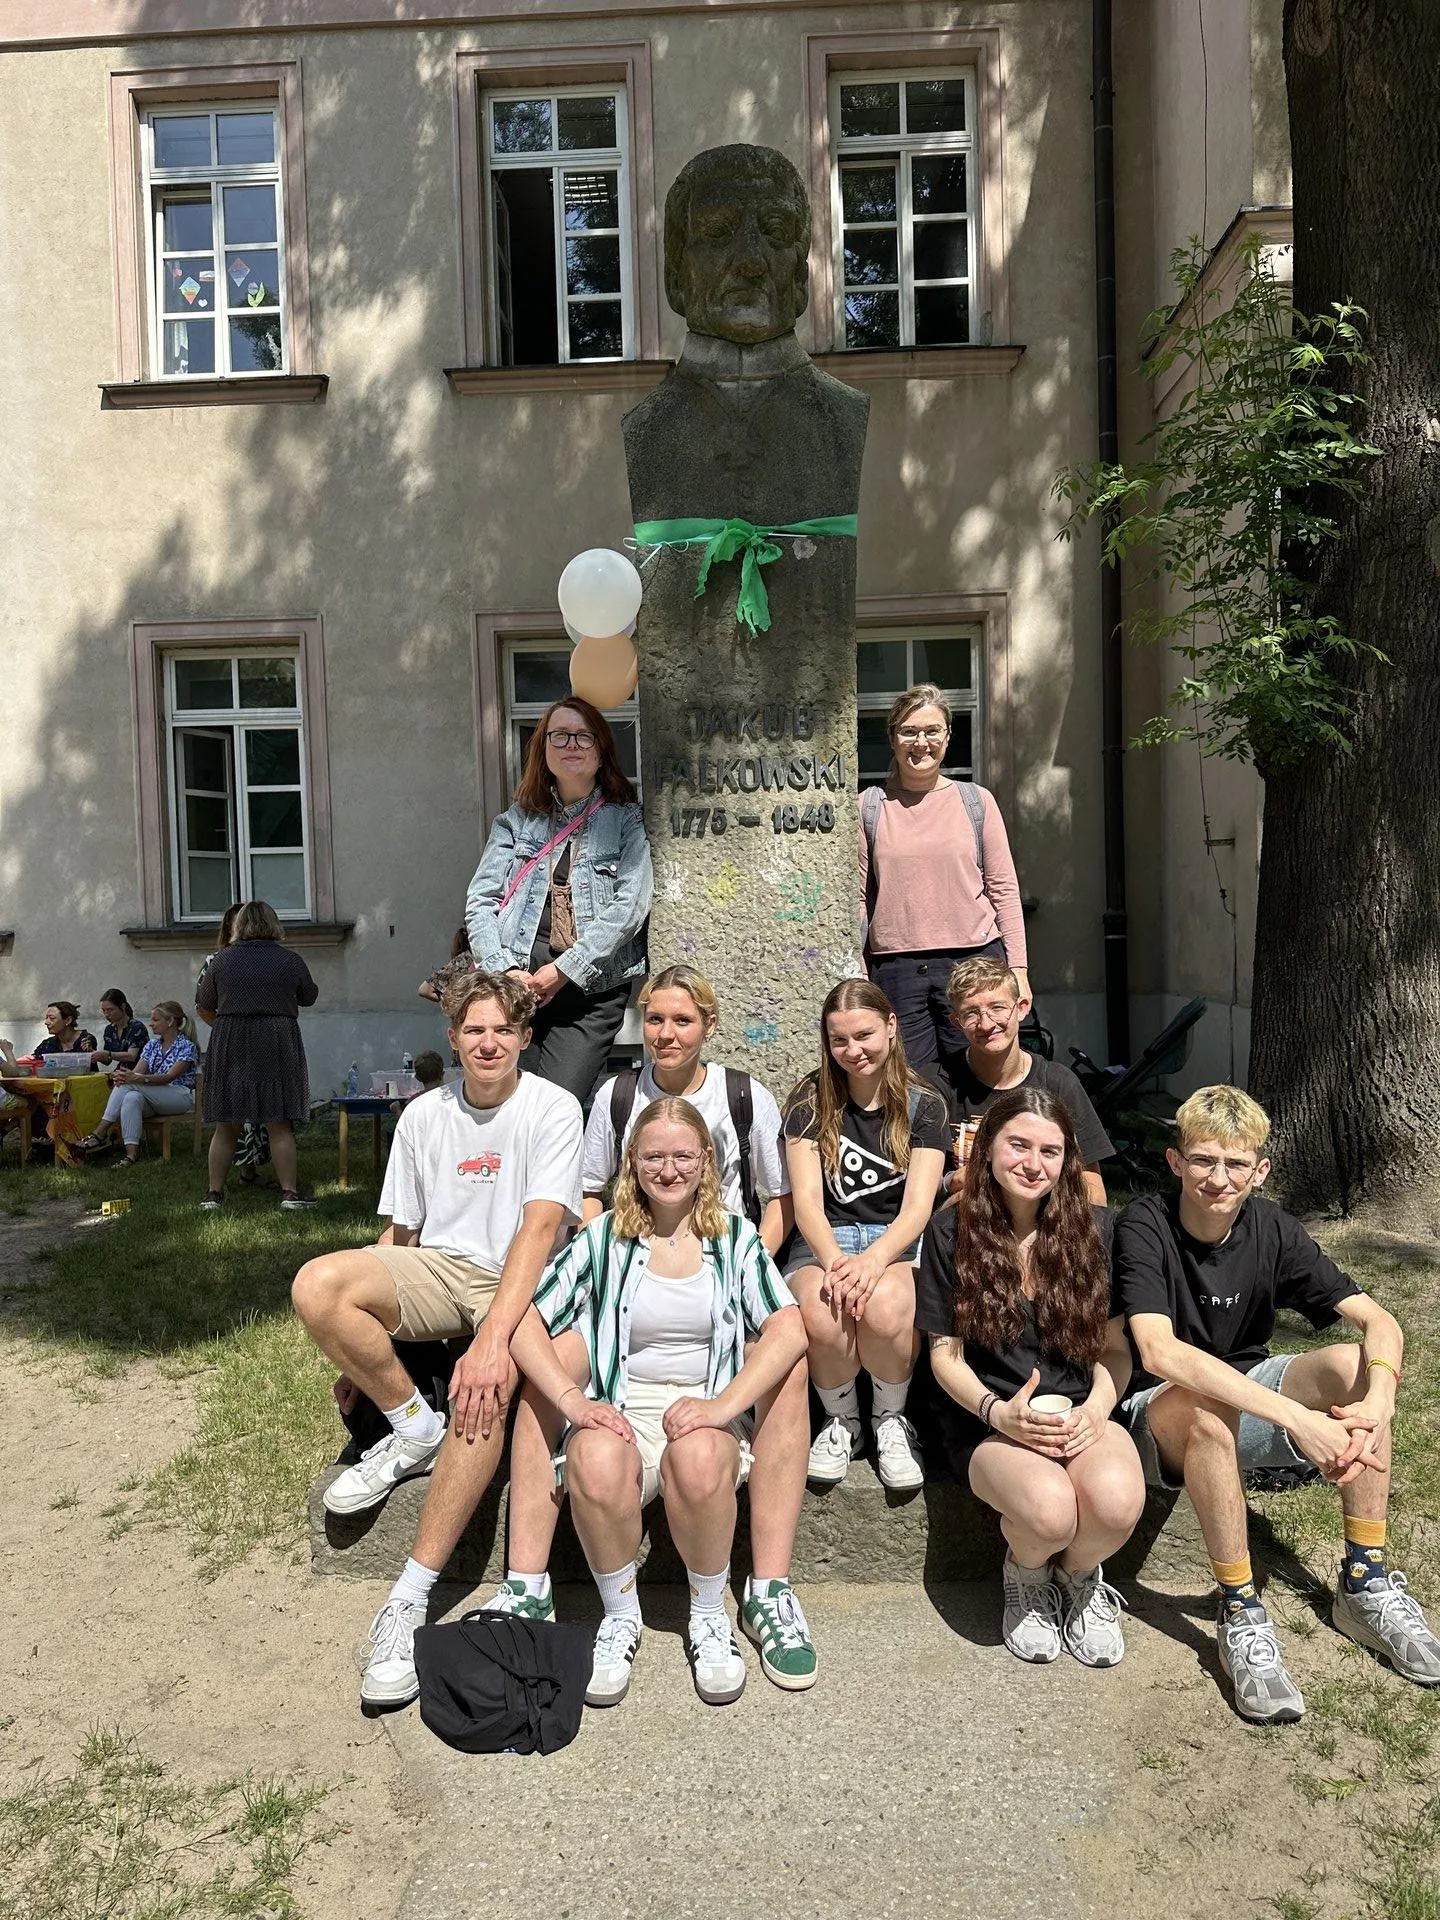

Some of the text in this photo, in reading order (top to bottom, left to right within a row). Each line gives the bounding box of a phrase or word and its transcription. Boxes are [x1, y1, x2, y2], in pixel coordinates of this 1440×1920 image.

[687, 704, 815, 743] JAKUB
[653, 754, 846, 795] FALKOWSKI
[671, 807, 727, 838] 1775
[771, 803, 836, 834] 1848
